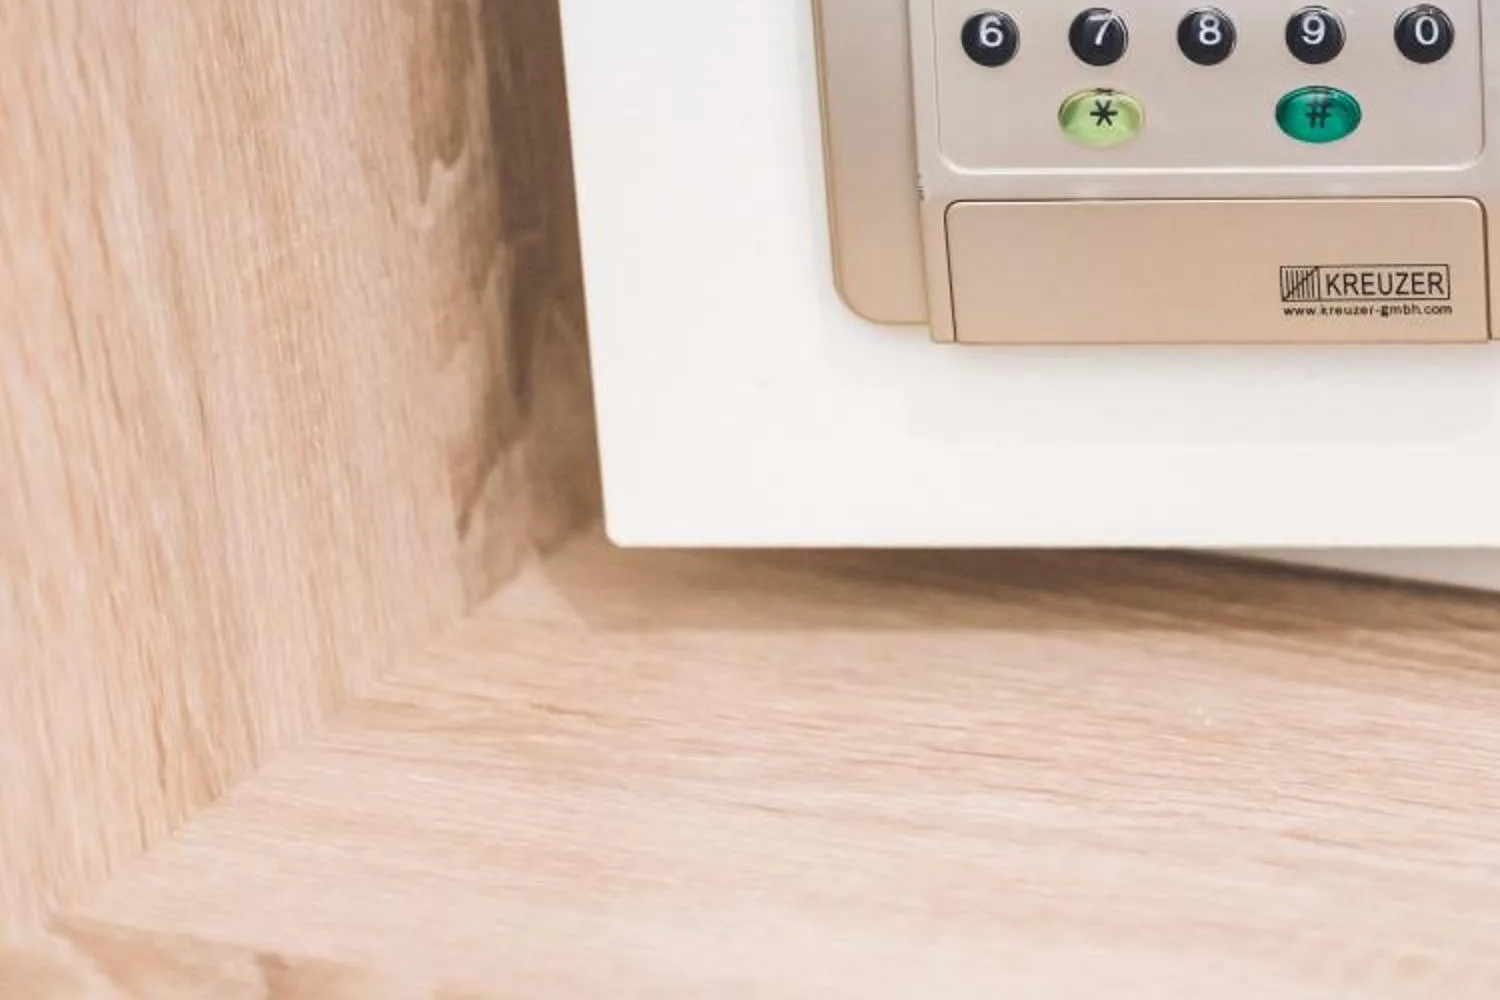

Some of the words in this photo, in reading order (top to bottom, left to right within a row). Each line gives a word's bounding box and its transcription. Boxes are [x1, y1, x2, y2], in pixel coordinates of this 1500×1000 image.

[979, 17, 1004, 48] 6
[1090, 14, 1114, 45] 7
[1198, 14, 1223, 45] 8
[1302, 15, 1326, 45] 9
[1415, 16, 1439, 46] 0
[1305, 99, 1332, 129] #
[1325, 271, 1445, 296] KREUZER
[1282, 303, 1453, 318] www.kreuzer-gmbh.com
